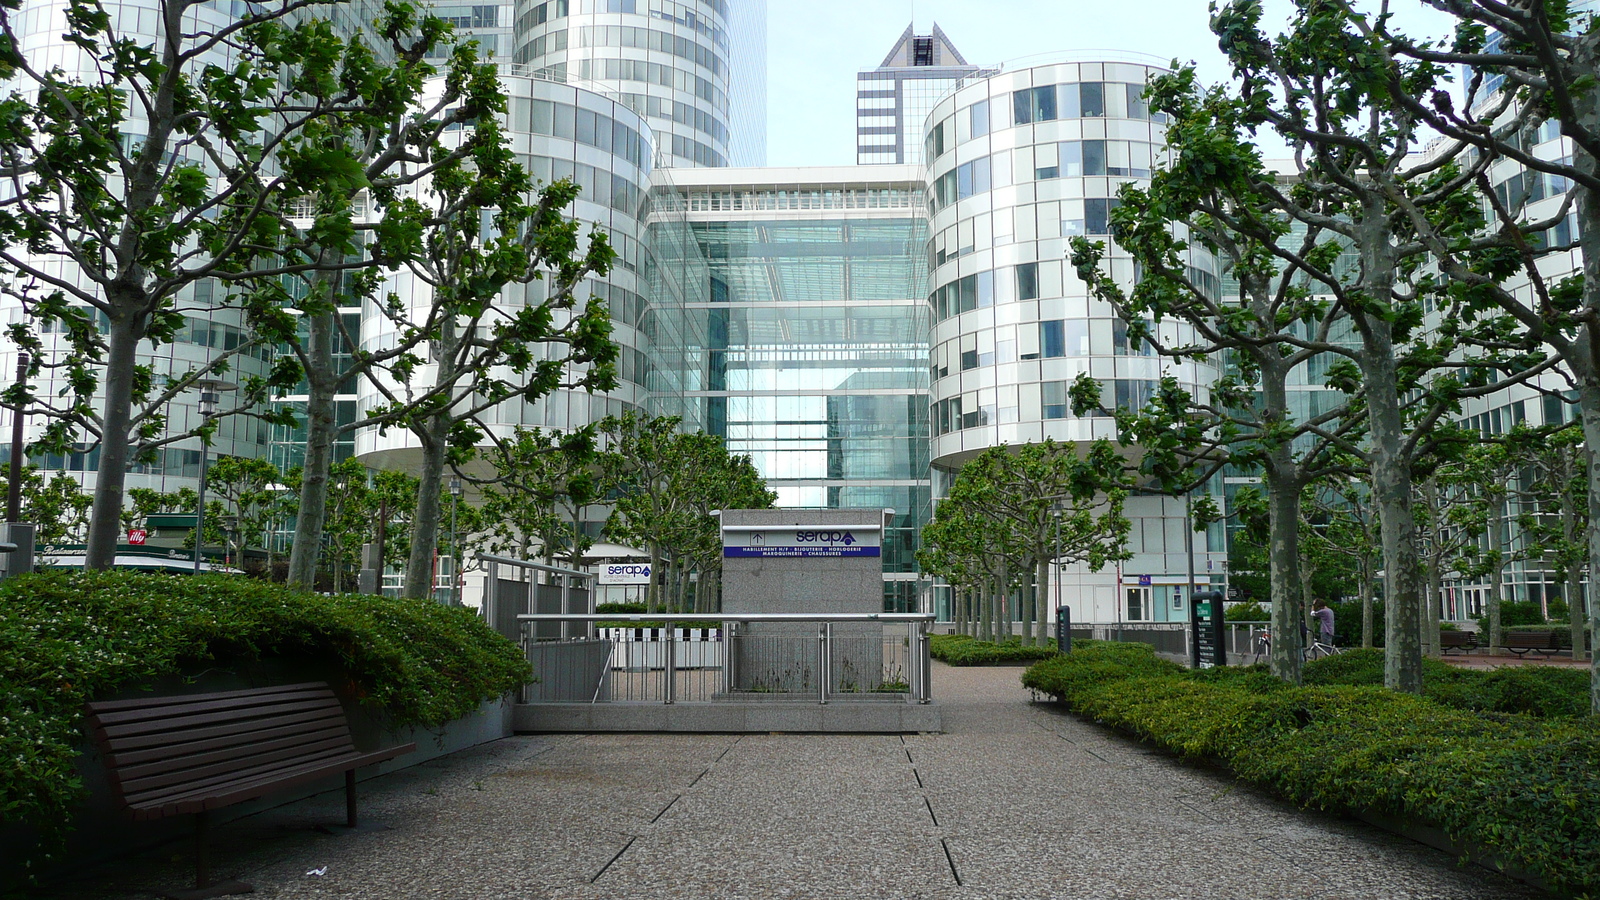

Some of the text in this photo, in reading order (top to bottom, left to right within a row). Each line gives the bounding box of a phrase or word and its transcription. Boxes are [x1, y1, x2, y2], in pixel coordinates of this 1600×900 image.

[129, 531, 145, 544] illy
[796, 531, 841, 546] serap
[42, 545, 88, 555] Restauran
[608, 566, 642, 578] serap
